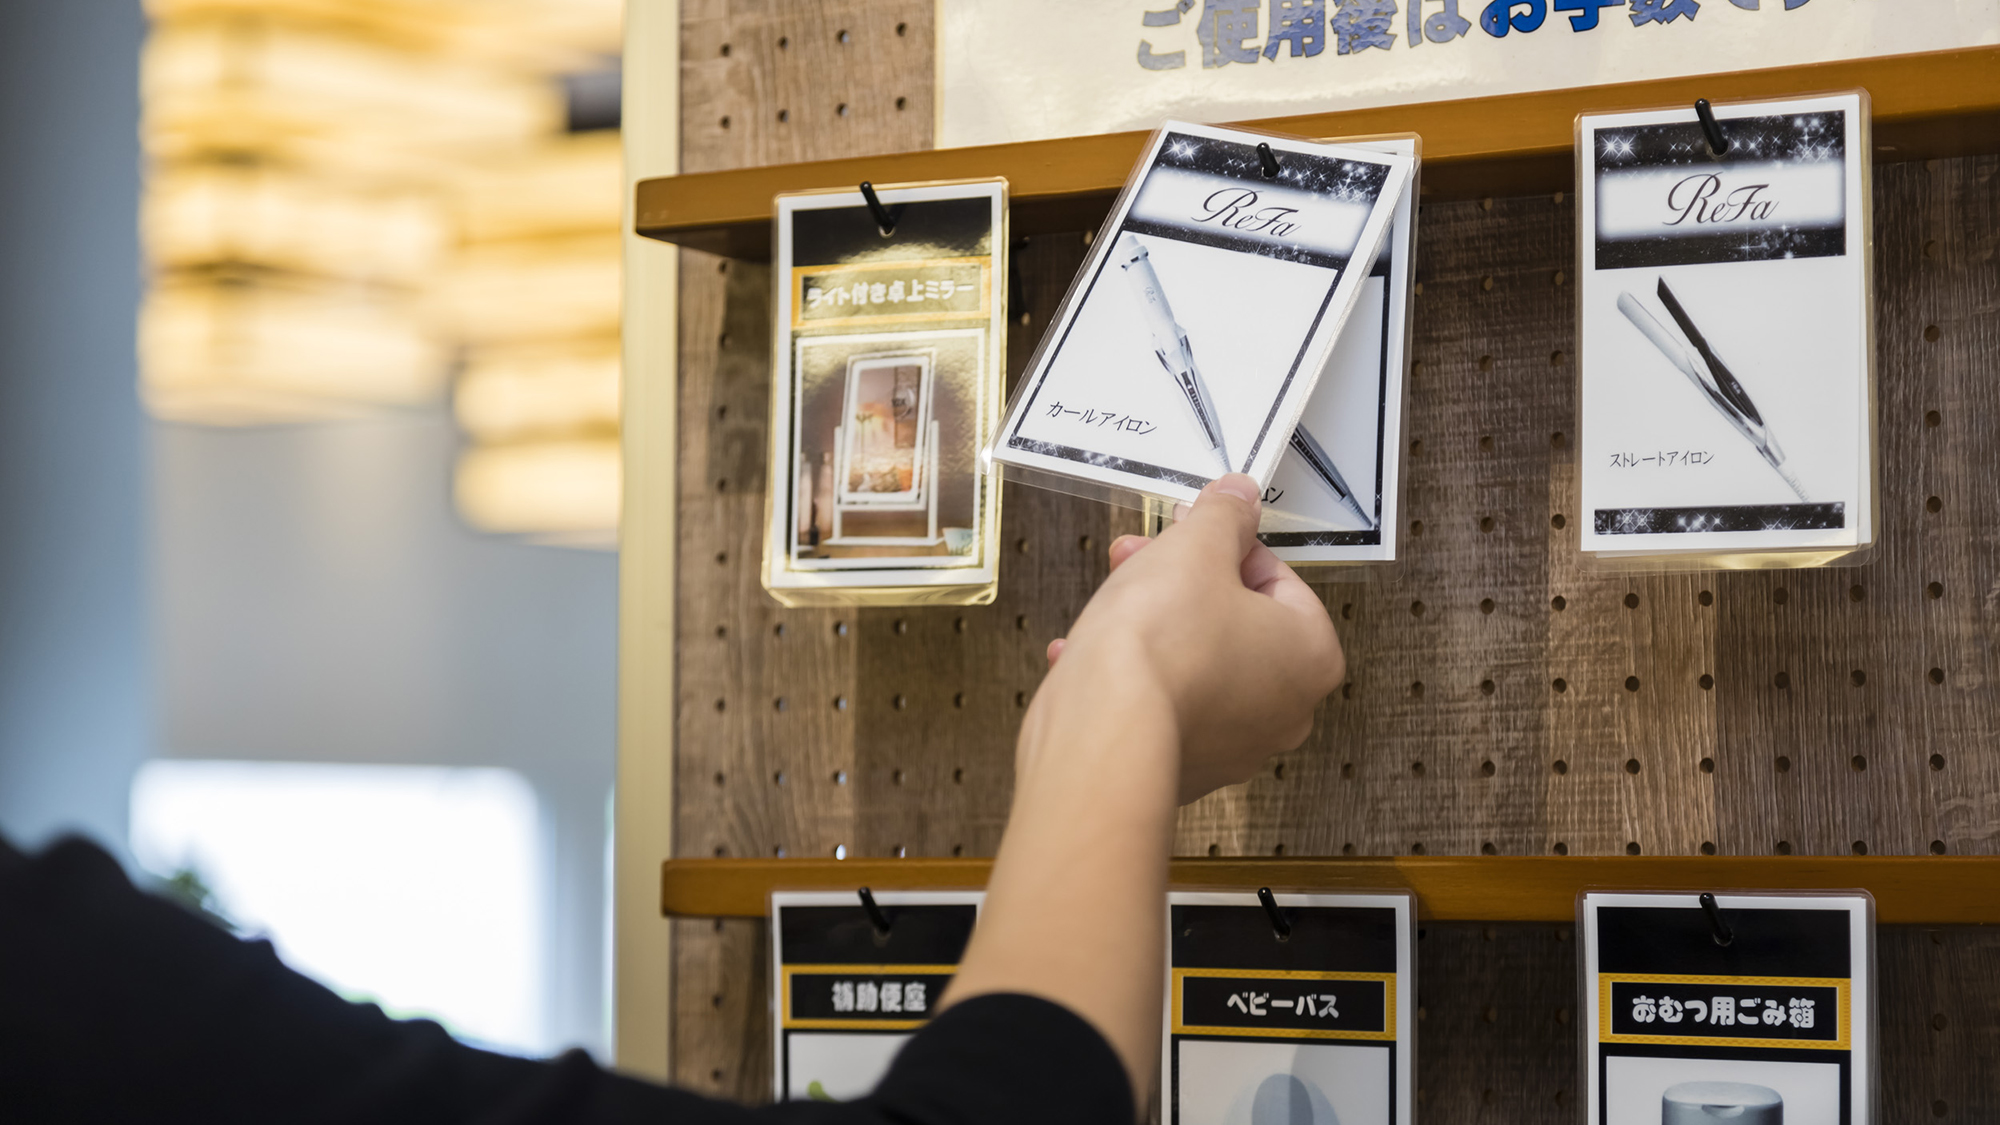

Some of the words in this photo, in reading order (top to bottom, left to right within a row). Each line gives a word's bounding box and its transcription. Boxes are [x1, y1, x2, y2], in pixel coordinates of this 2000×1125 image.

[1137, 0, 1810, 70] ご使用後はお
[1191, 187, 1304, 238] ReFa
[1662, 171, 1780, 226] ReFa
[806, 279, 975, 309] ライト付き卓上ミラー
[1046, 401, 1158, 436] カールアイロン
[1609, 449, 1715, 468] ストレートアイロン
[832, 981, 927, 1012] 補助便座
[1227, 991, 1340, 1019] ベビーバス
[1632, 995, 1815, 1029] おむつ用ごみ箱
